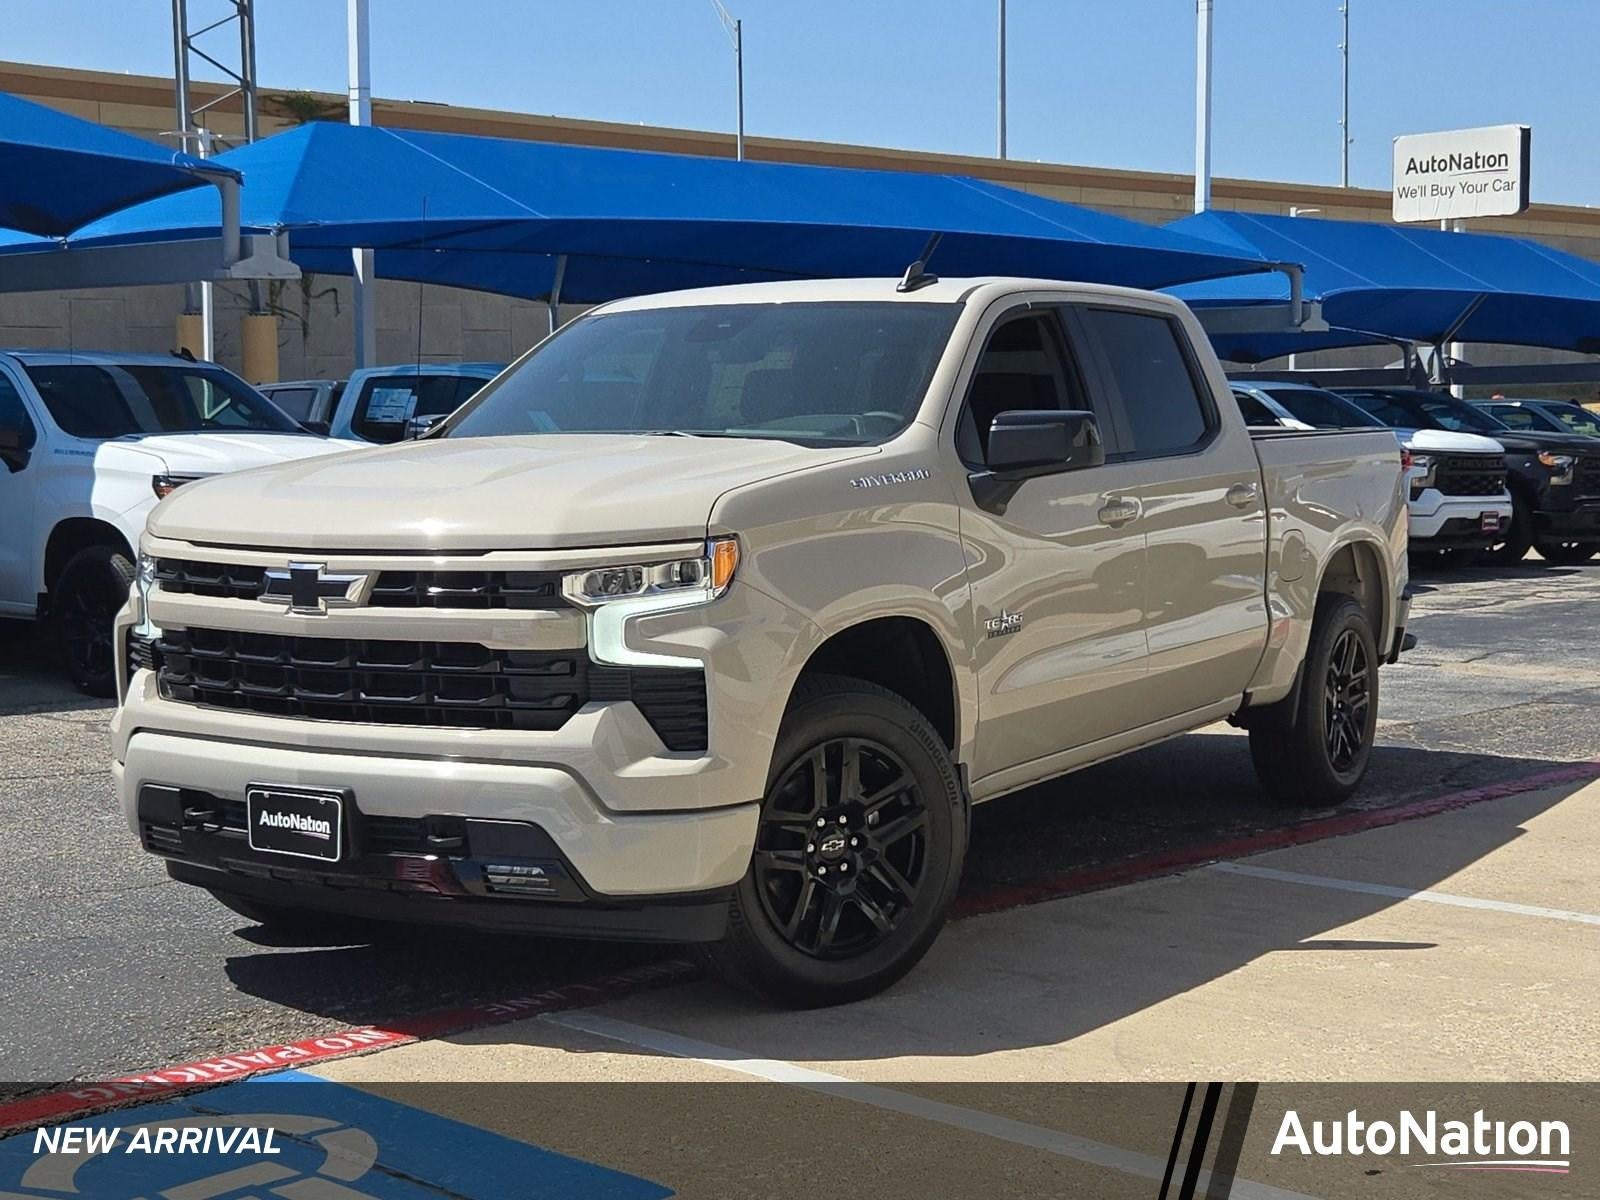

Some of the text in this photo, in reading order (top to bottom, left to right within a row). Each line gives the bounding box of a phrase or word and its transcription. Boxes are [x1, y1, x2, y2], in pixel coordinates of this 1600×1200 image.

[1405, 151, 1508, 175] AutoNation
[1397, 179, 1516, 199] We'll Buy Your Car
[259, 810, 331, 834] AutoNation
[316, 1029, 389, 1051] NO
[68, 1046, 313, 1099] PARKING
